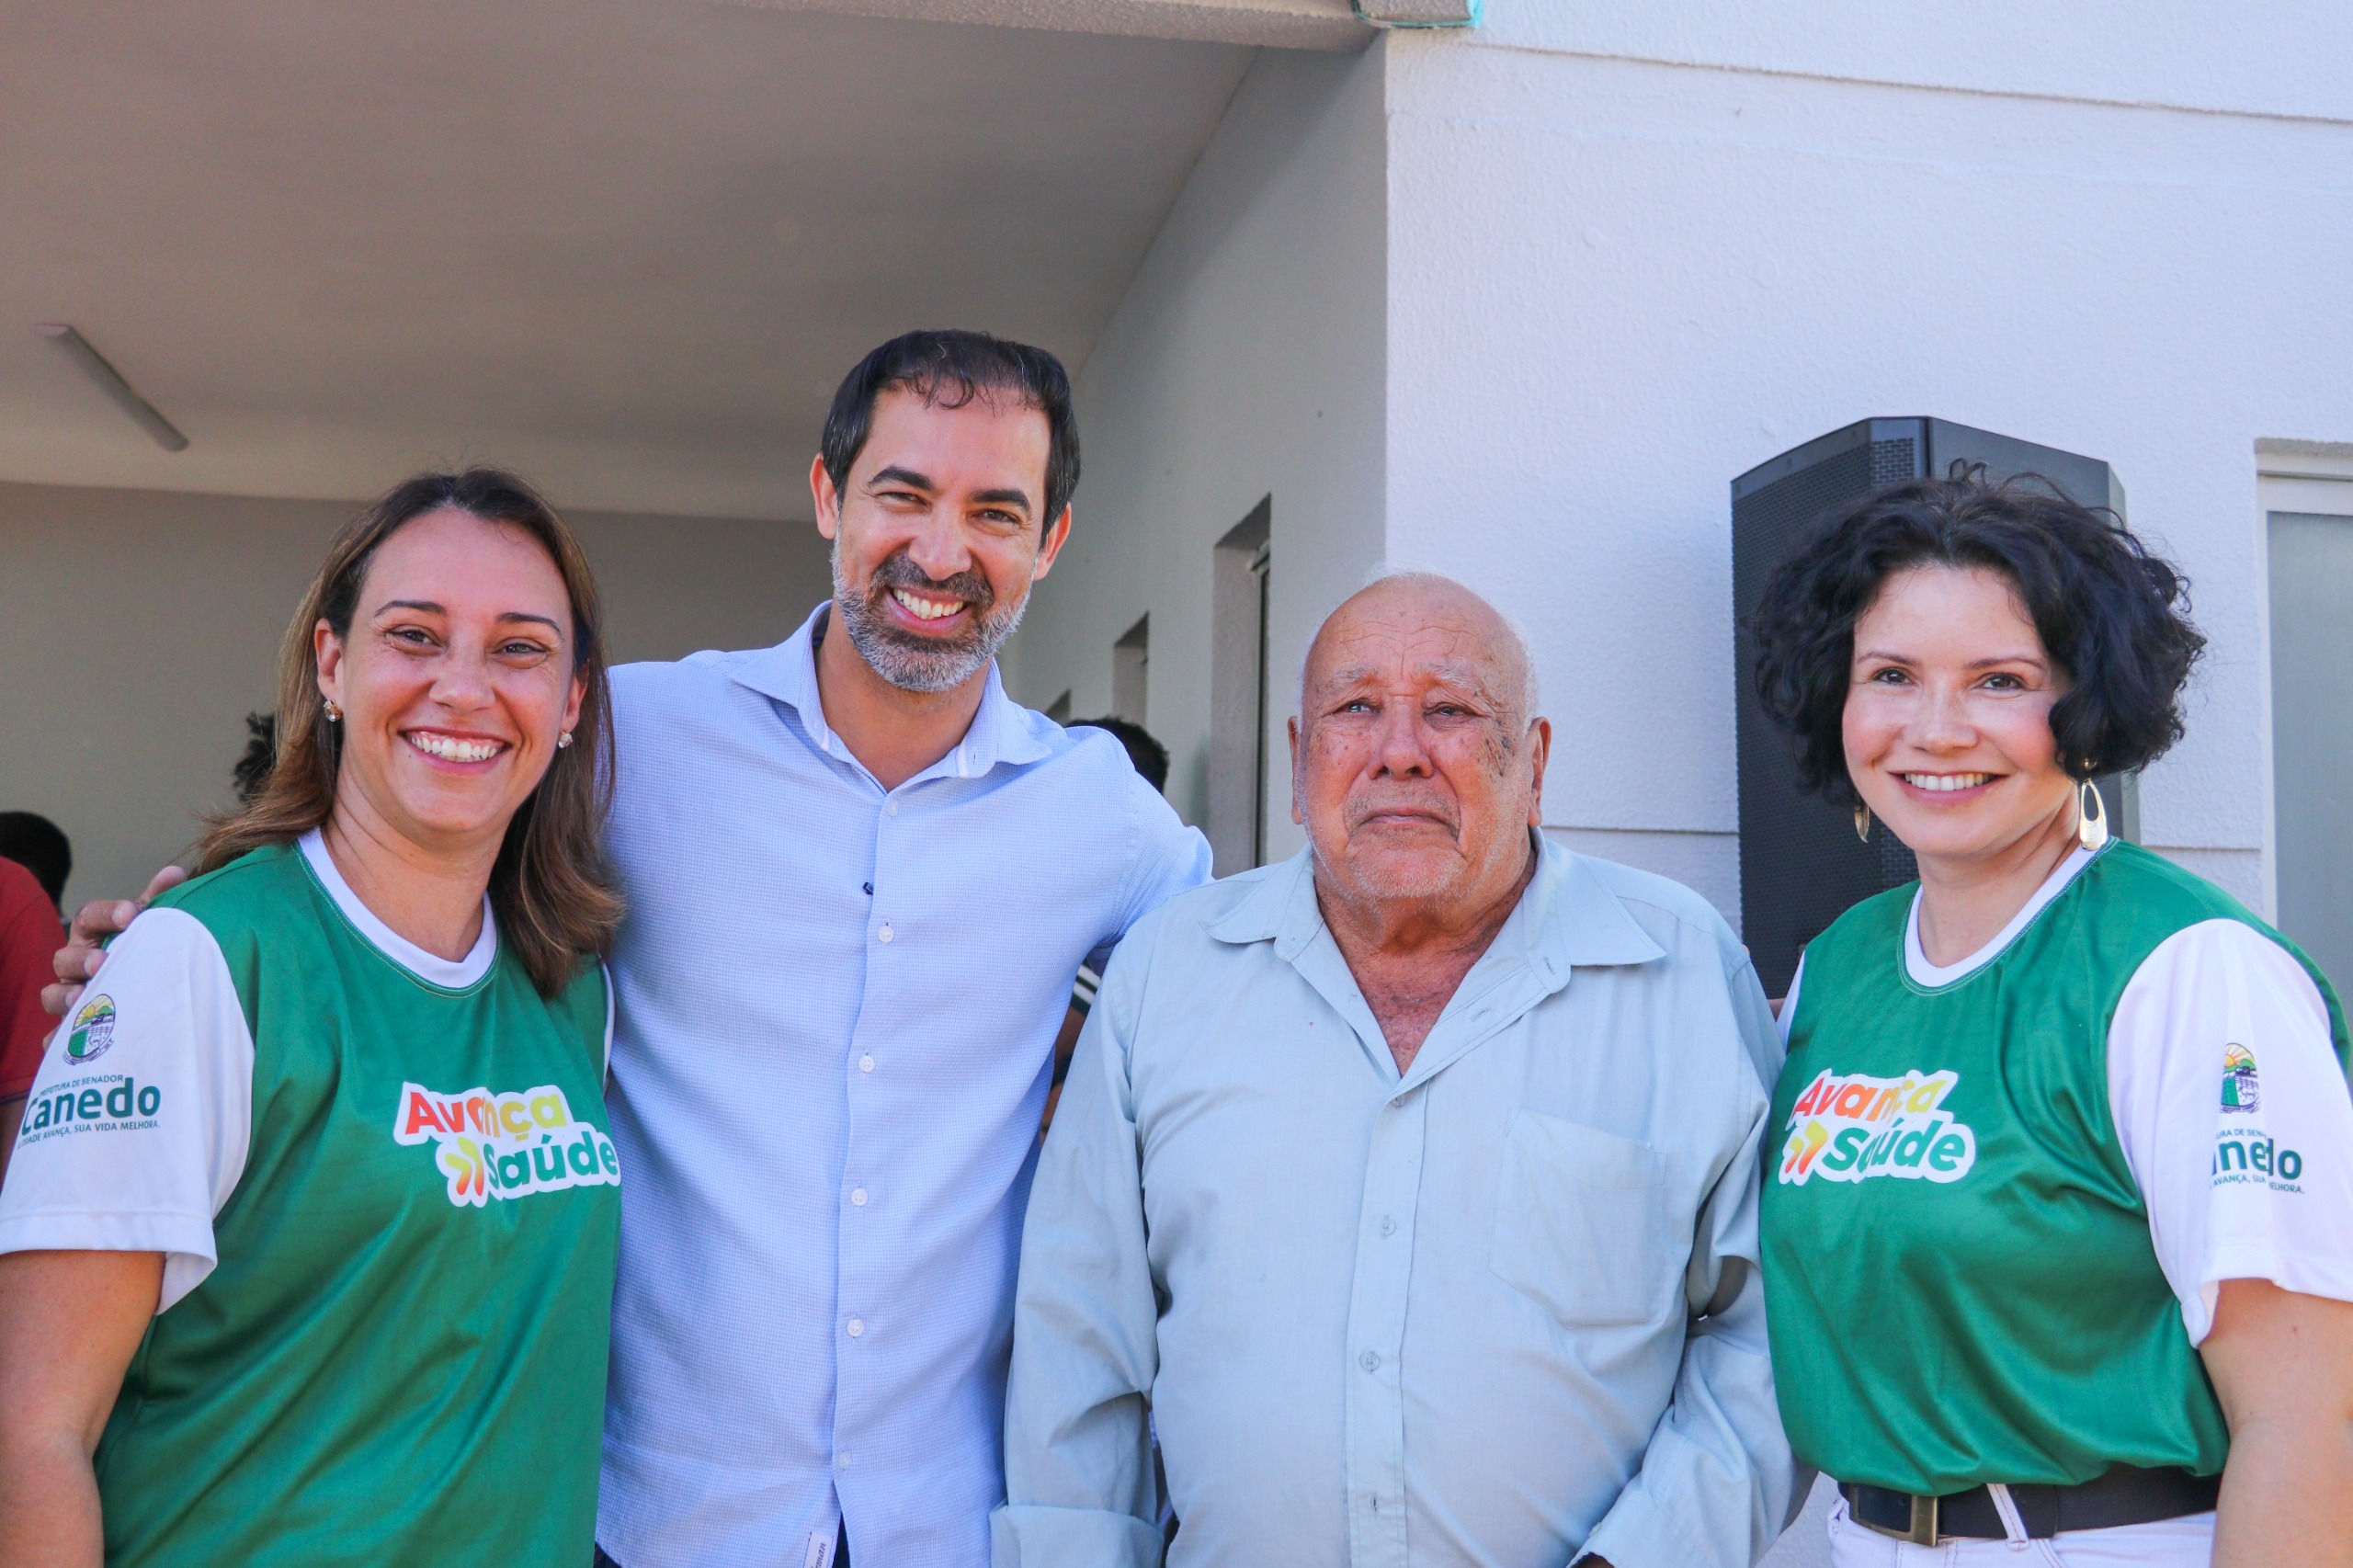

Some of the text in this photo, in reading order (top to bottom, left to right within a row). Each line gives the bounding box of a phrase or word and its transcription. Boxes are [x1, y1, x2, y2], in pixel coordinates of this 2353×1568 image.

[72, 1078, 81, 1087] DE
[81, 1074, 124, 1085] SENADOR
[21, 1077, 161, 1136] Canedo
[74, 1123, 92, 1133] SUA
[95, 1122, 118, 1132] VIDA
[120, 1119, 161, 1131] MELHORA.
[404, 1091, 567, 1142] Avança
[483, 1131, 619, 1191] Saúde
